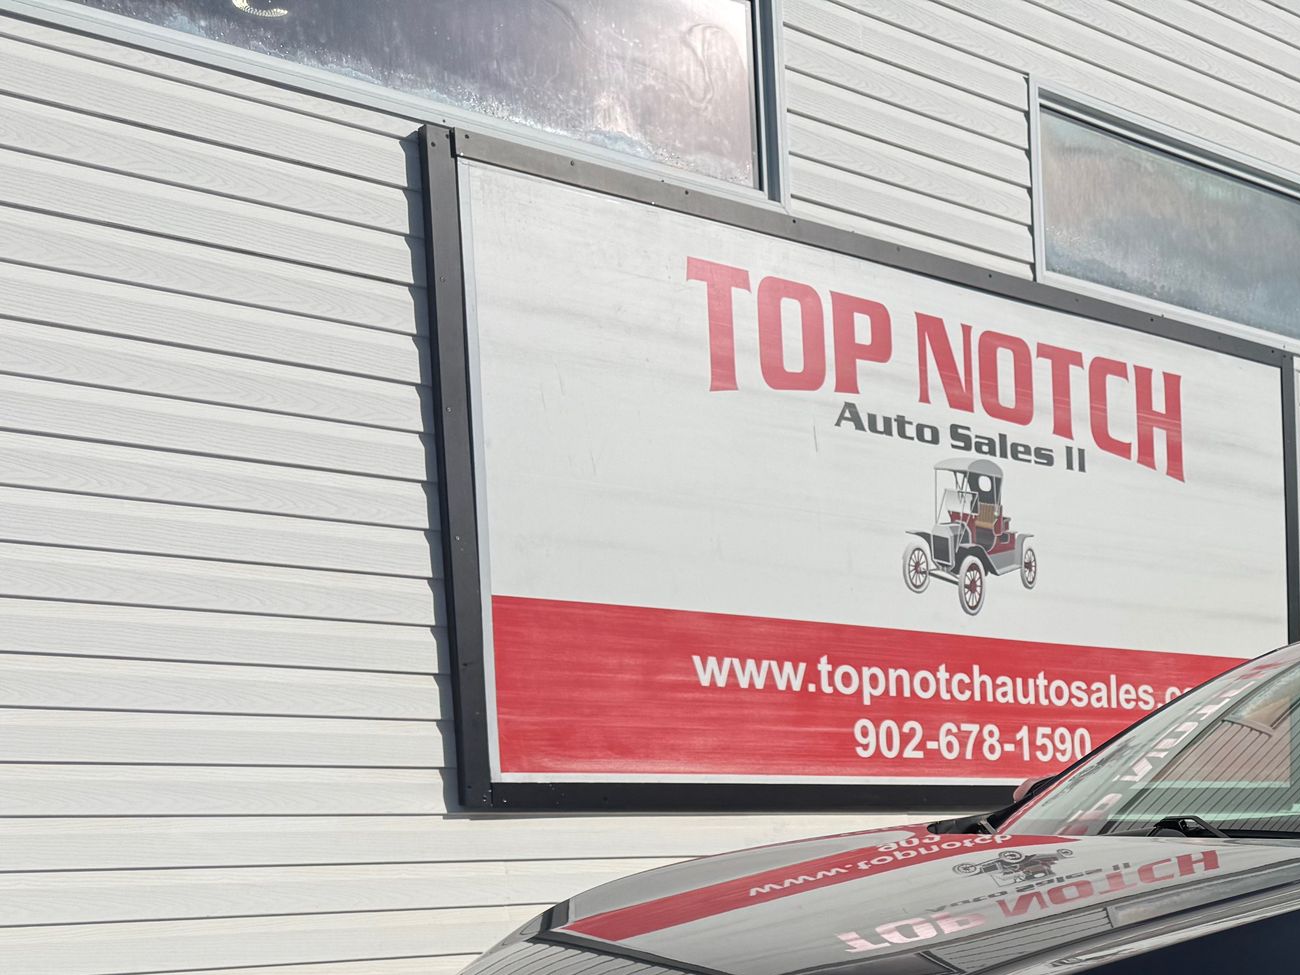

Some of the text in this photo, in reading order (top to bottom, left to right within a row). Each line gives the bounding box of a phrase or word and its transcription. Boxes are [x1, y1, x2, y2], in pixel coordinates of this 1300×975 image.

[686, 255, 1185, 483] TOP NOTCH
[834, 401, 940, 445] Auto
[949, 424, 1055, 467] Sales
[853, 718, 1092, 762] 902-678-1590
